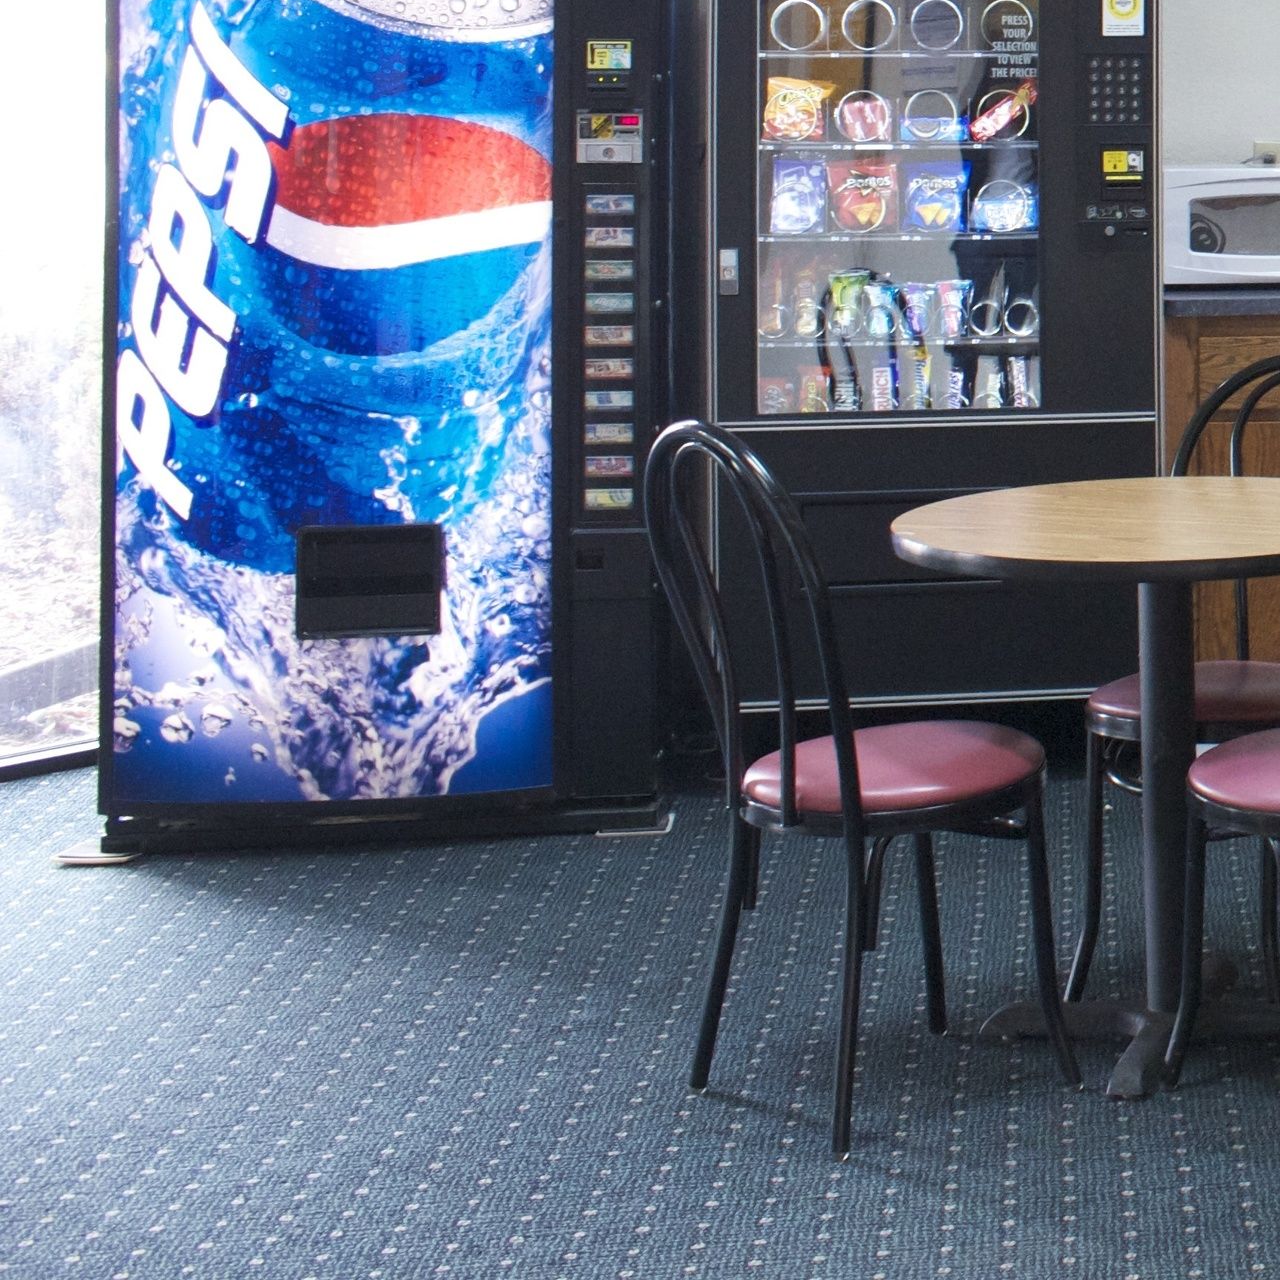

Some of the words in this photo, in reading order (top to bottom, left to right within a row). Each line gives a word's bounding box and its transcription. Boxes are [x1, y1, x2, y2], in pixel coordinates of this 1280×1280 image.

[1001, 16, 1028, 26] PRESS
[1002, 28, 1027, 38] YOUR
[992, 41, 1037, 52] SELECTION
[998, 54, 1008, 64] TO
[1009, 54, 1032, 64] VIEW
[991, 68, 1008, 78] THE
[1009, 68, 1037, 78] PRICE!
[845, 176, 891, 188] Doritos
[876, 368, 889, 411] RUNCH
